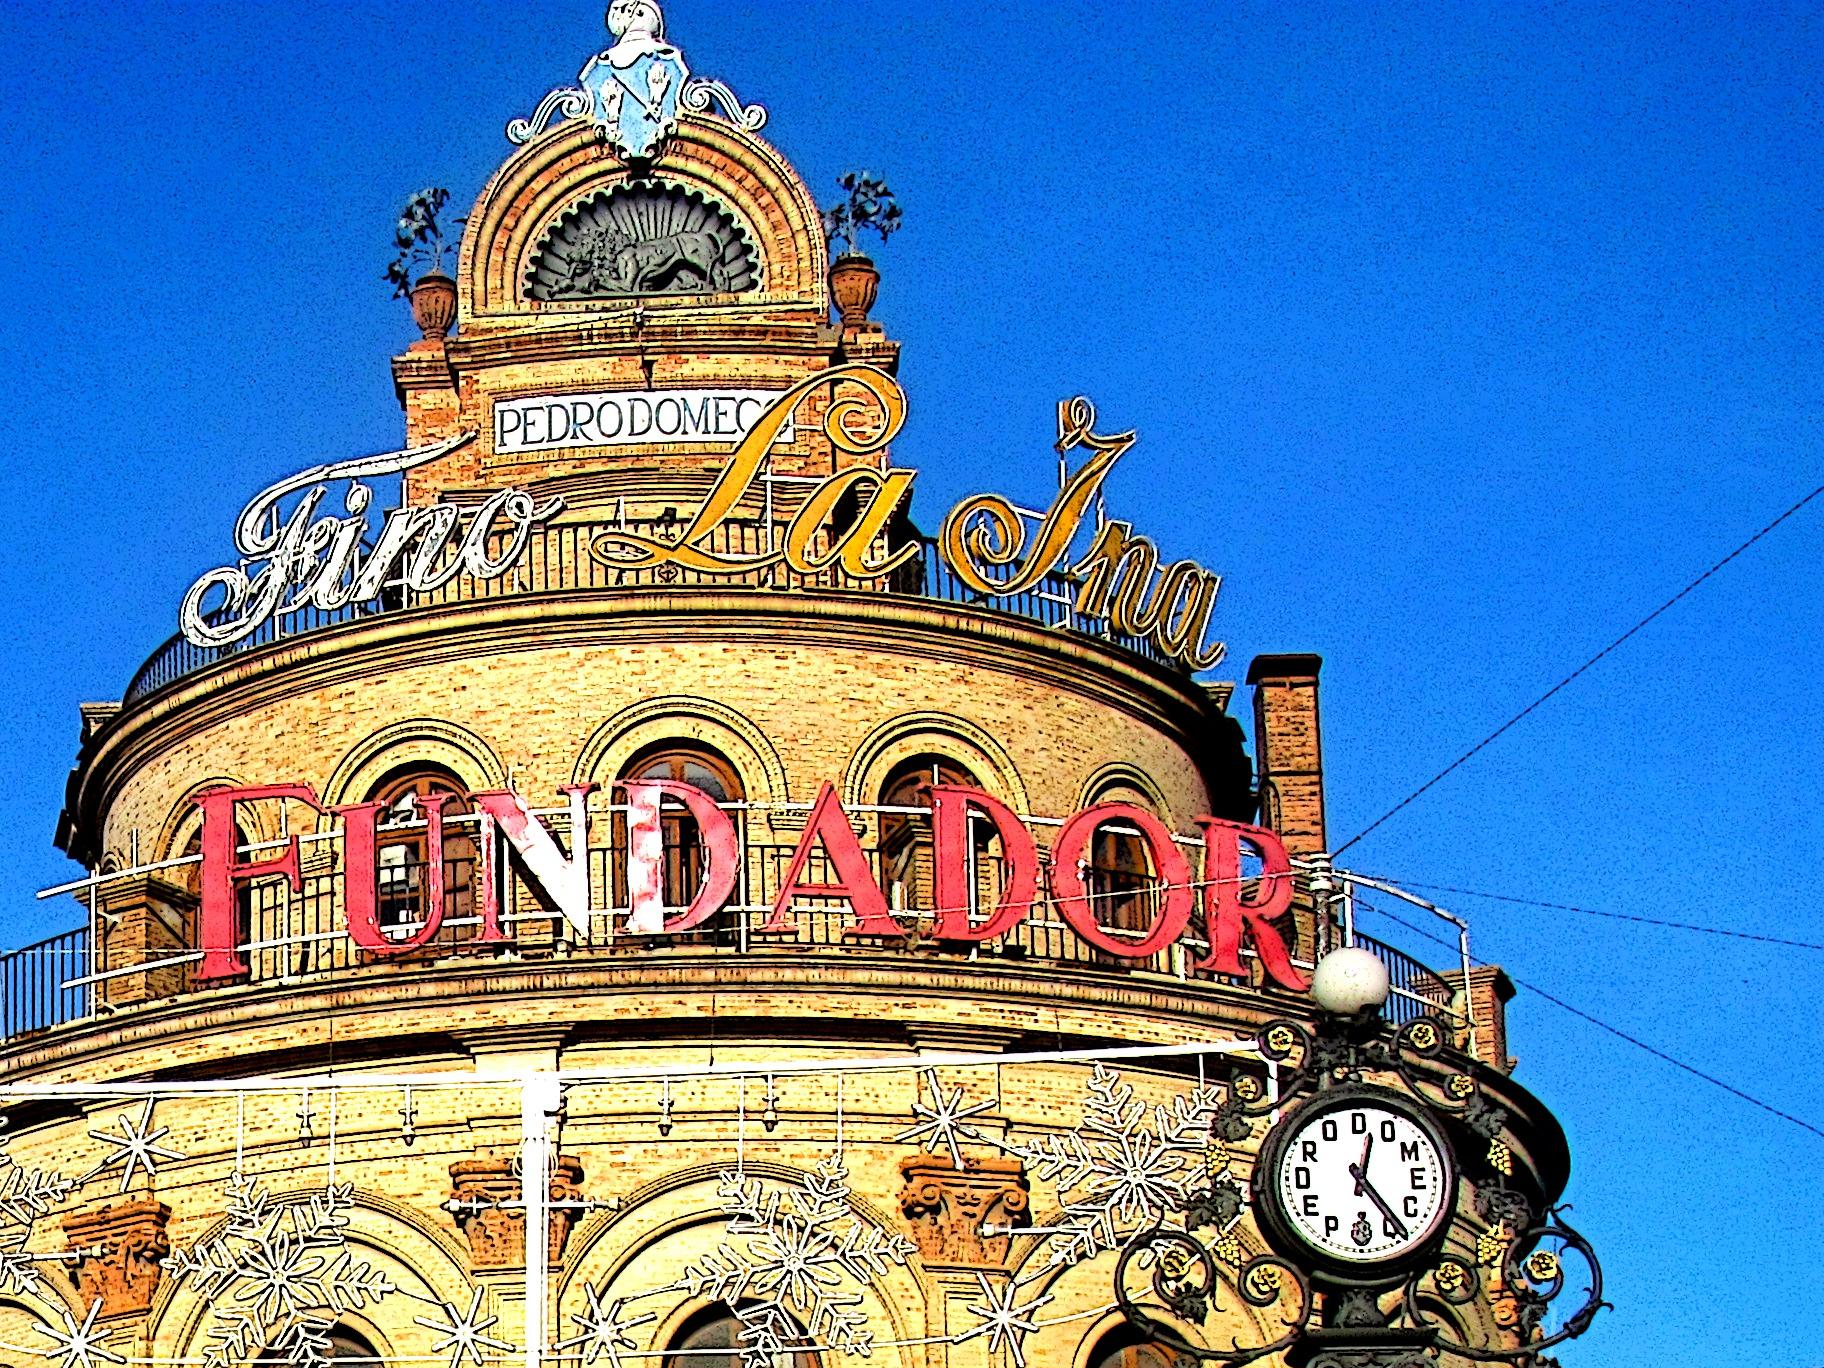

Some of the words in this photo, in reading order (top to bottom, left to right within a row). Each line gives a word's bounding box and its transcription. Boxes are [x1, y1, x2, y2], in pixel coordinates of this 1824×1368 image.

[497, 400, 624, 447] PEDRO
[627, 396, 792, 438] DOMEC
[590, 362, 920, 582] La
[179, 432, 564, 648] Fino
[190, 779, 1314, 994] FUNDADOR
